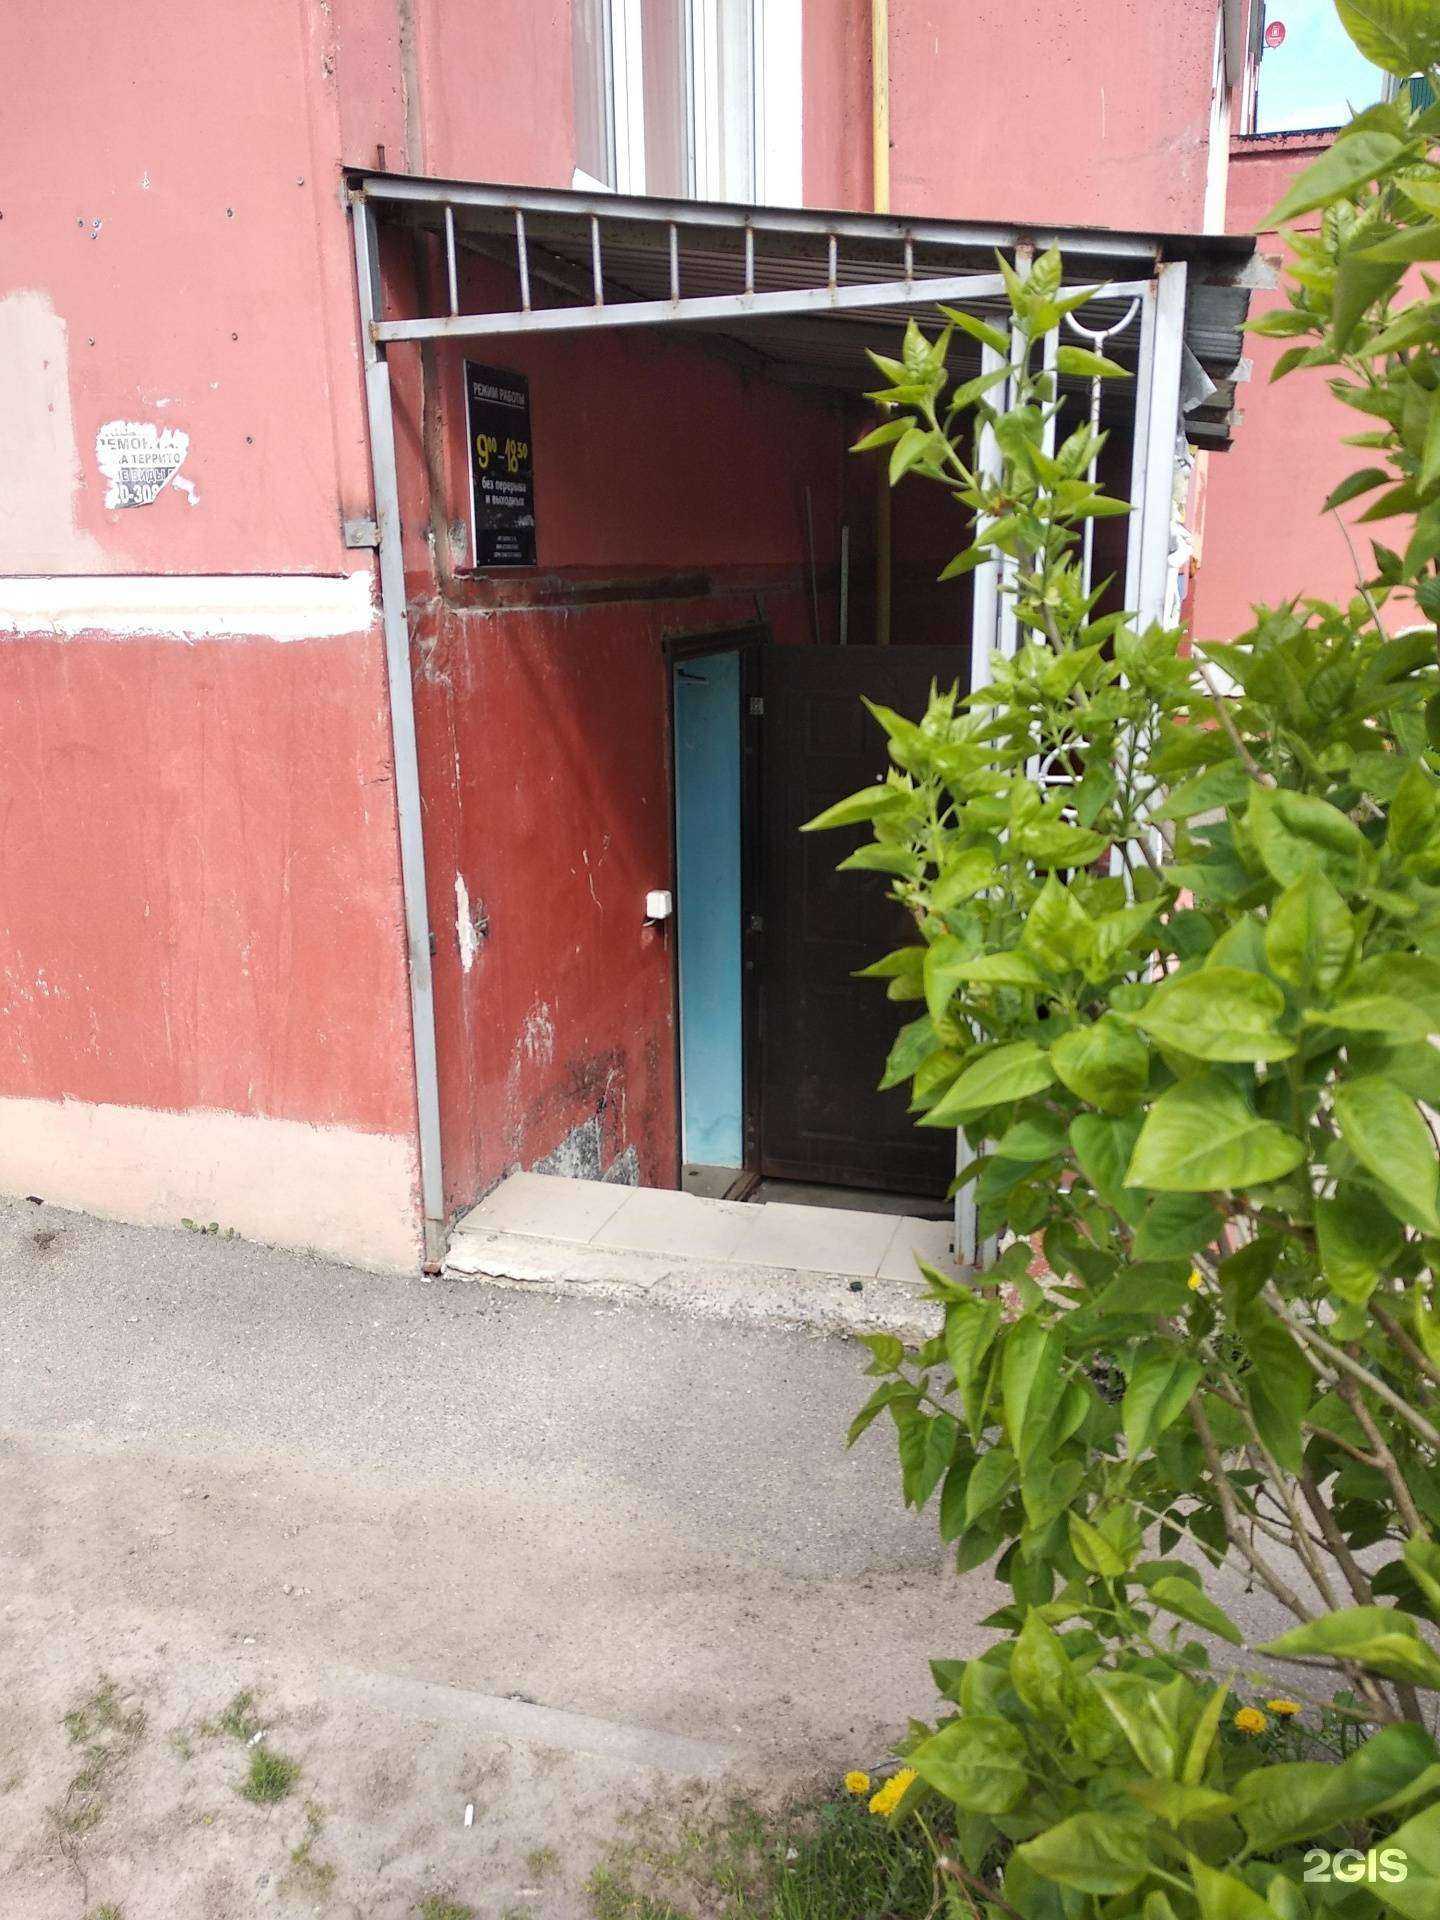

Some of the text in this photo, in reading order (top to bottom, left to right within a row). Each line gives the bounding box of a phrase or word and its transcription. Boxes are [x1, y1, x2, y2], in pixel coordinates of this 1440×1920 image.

[473, 382, 525, 405] РЕЖИМ РАБОТЫ
[132, 469, 166, 483] ВИДЫ
[481, 476, 526, 494] без перерыва
[492, 495, 525, 507] выходных
